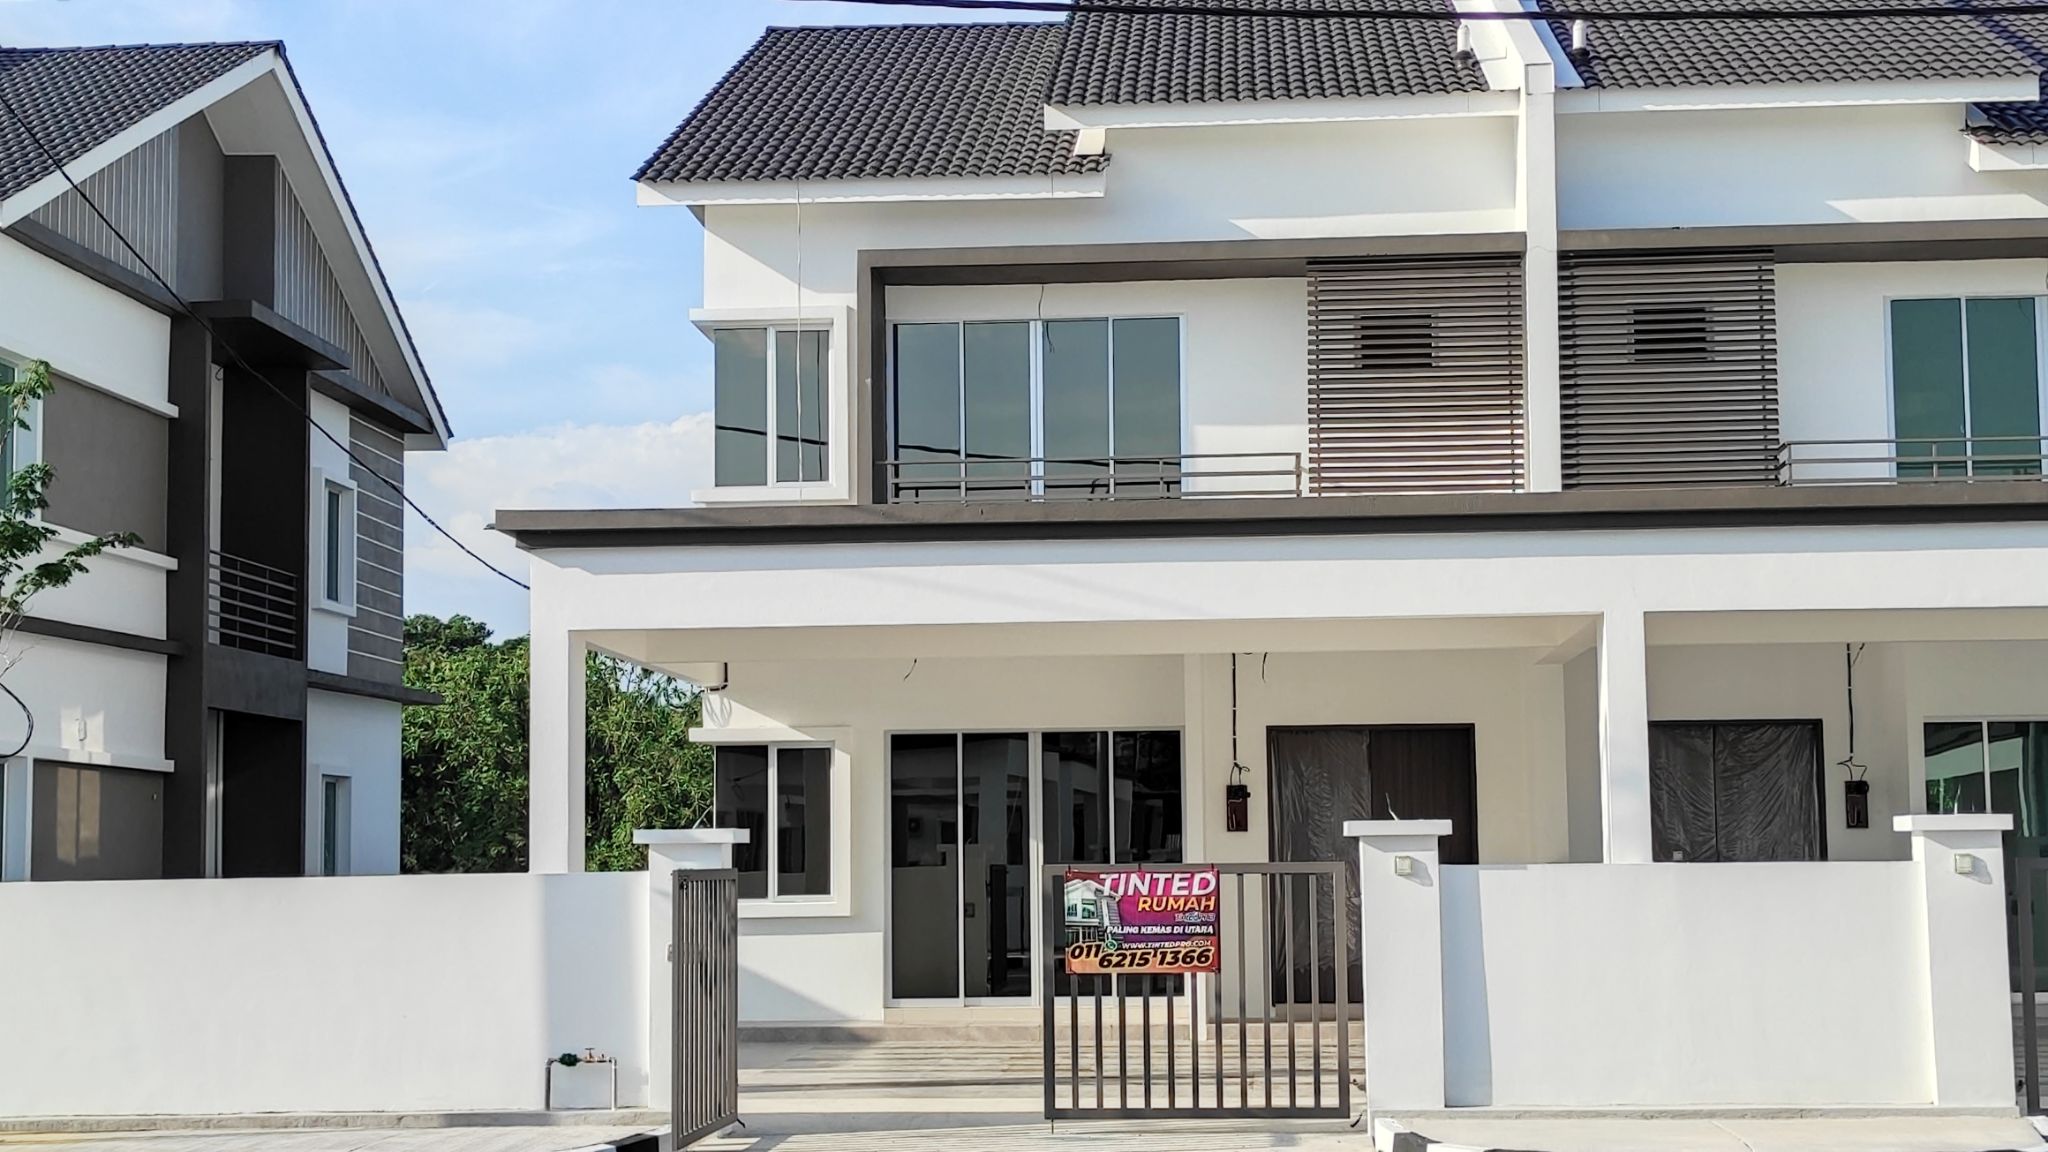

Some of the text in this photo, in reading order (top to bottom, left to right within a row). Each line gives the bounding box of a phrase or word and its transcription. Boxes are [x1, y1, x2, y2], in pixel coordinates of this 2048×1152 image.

[1099, 873, 1216, 896] TINTED
[1138, 896, 1215, 912] RUMAH
[1106, 925, 1214, 934] PALING KEMAS DI UTARA
[1070, 943, 1212, 968] 011 6215 1366
